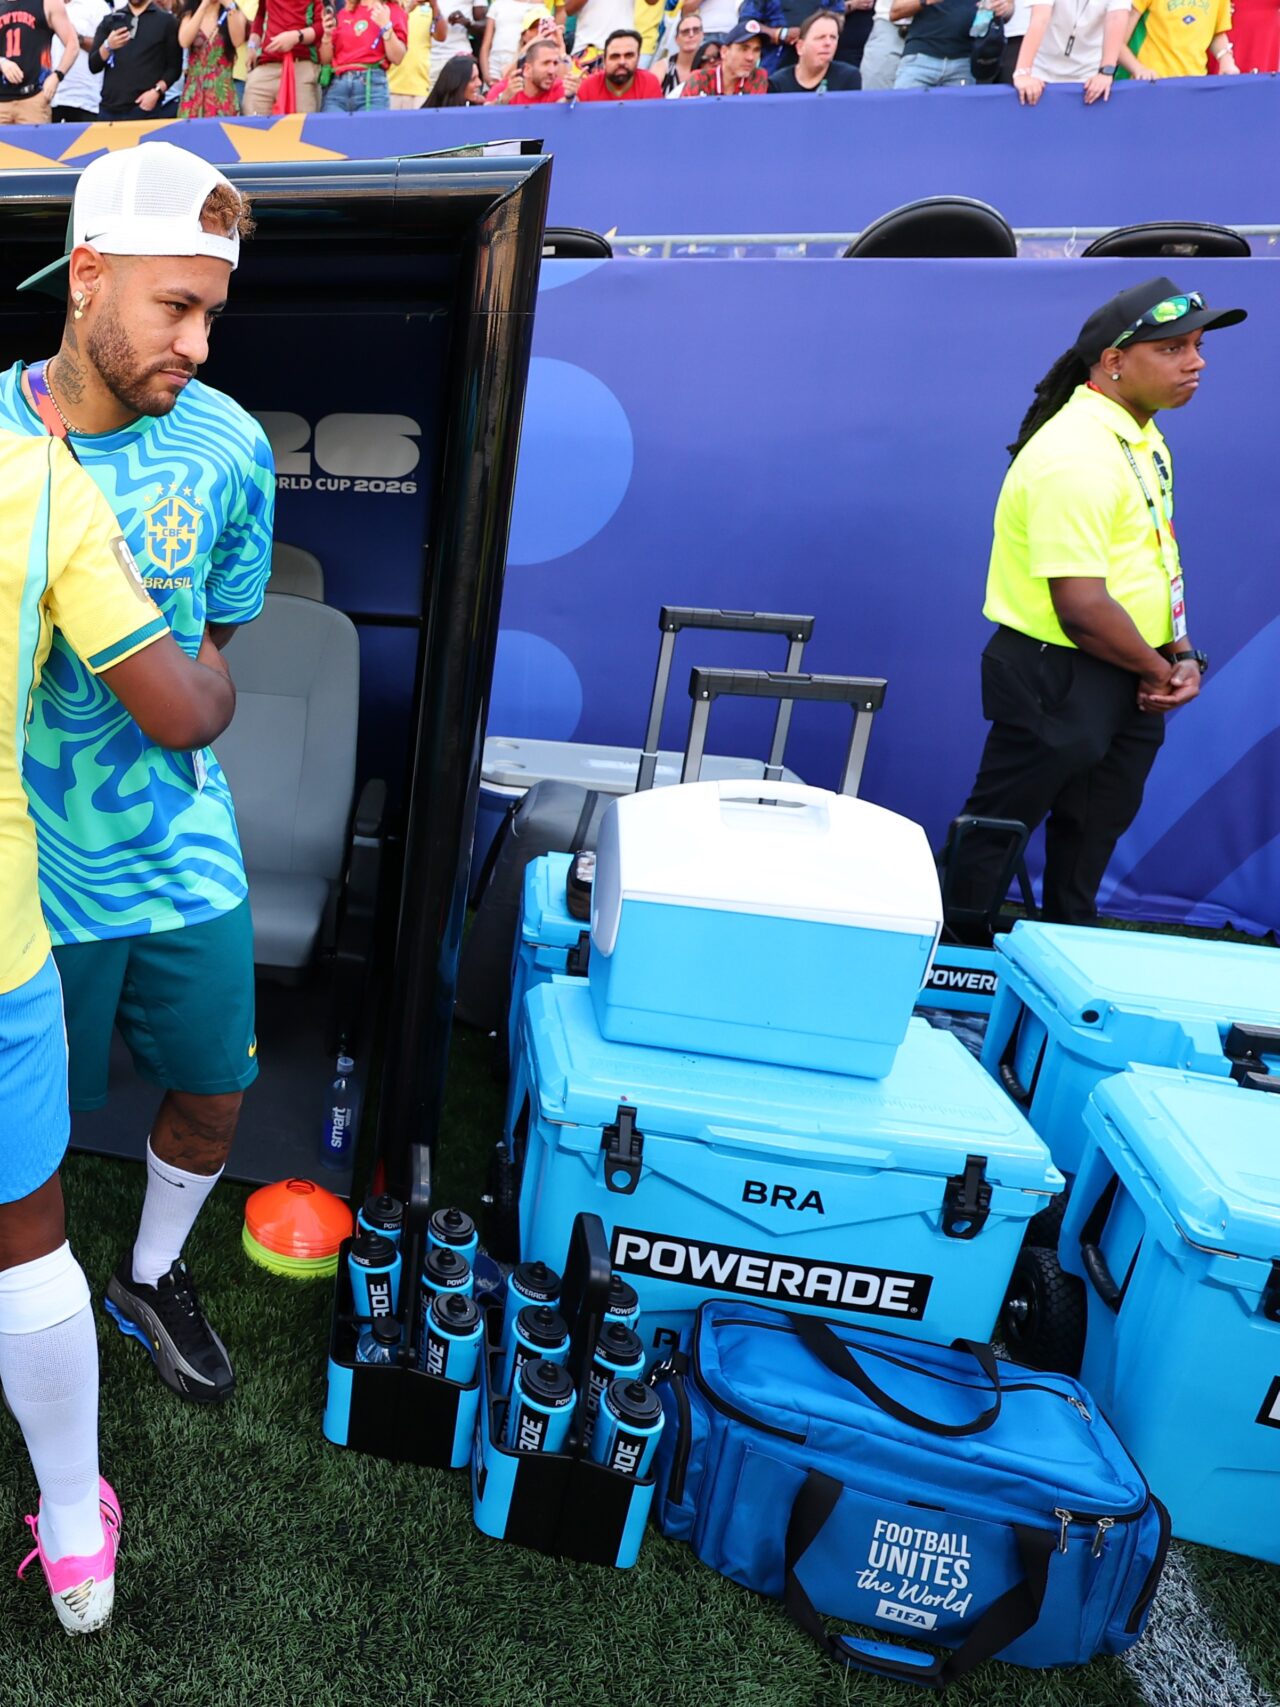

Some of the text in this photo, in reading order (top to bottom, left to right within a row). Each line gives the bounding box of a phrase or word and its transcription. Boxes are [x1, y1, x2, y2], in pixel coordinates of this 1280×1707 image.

[6, 27, 21, 58] 11
[275, 477, 417, 494] RLD CUP 2026
[162, 528, 182, 537] CBF
[144, 577, 192, 590] BRASIL
[331, 1106, 346, 1148] smart
[742, 1180, 825, 1214] BRA
[615, 1233, 915, 1312] POWERADE
[873, 1519, 971, 1558] FOOTBALL
[867, 1540, 970, 1589] UNITES
[855, 1568, 973, 1618] the World
[885, 1606, 927, 1626] FIFA
